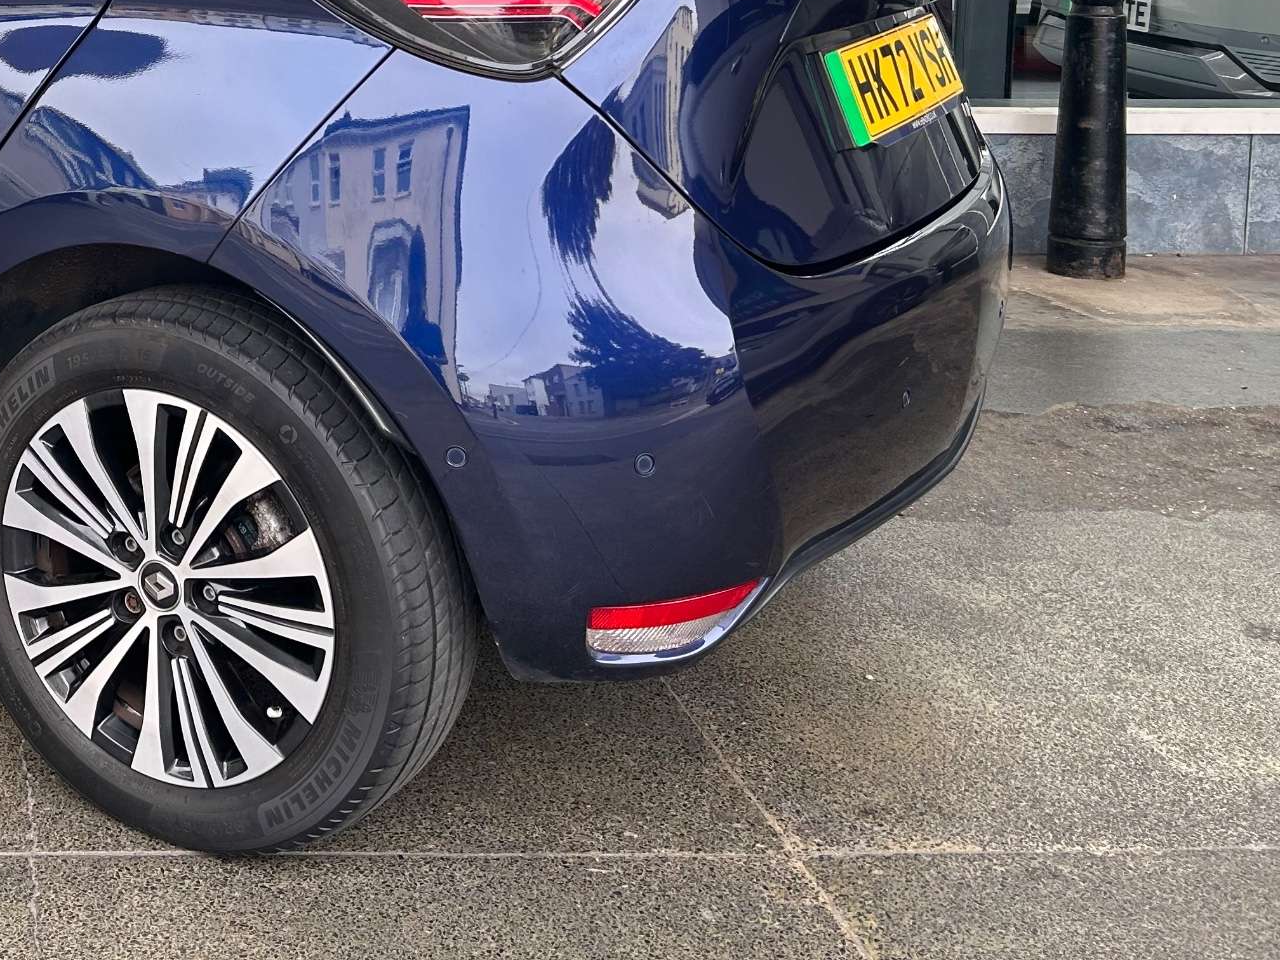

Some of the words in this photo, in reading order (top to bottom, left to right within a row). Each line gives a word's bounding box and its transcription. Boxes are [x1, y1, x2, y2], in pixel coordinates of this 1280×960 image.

[1125, 0, 1148, 27] TE
[848, 39, 925, 124] HK72
[196, 363, 257, 402] OUTSIDE
[263, 718, 362, 828] MICHELIN
